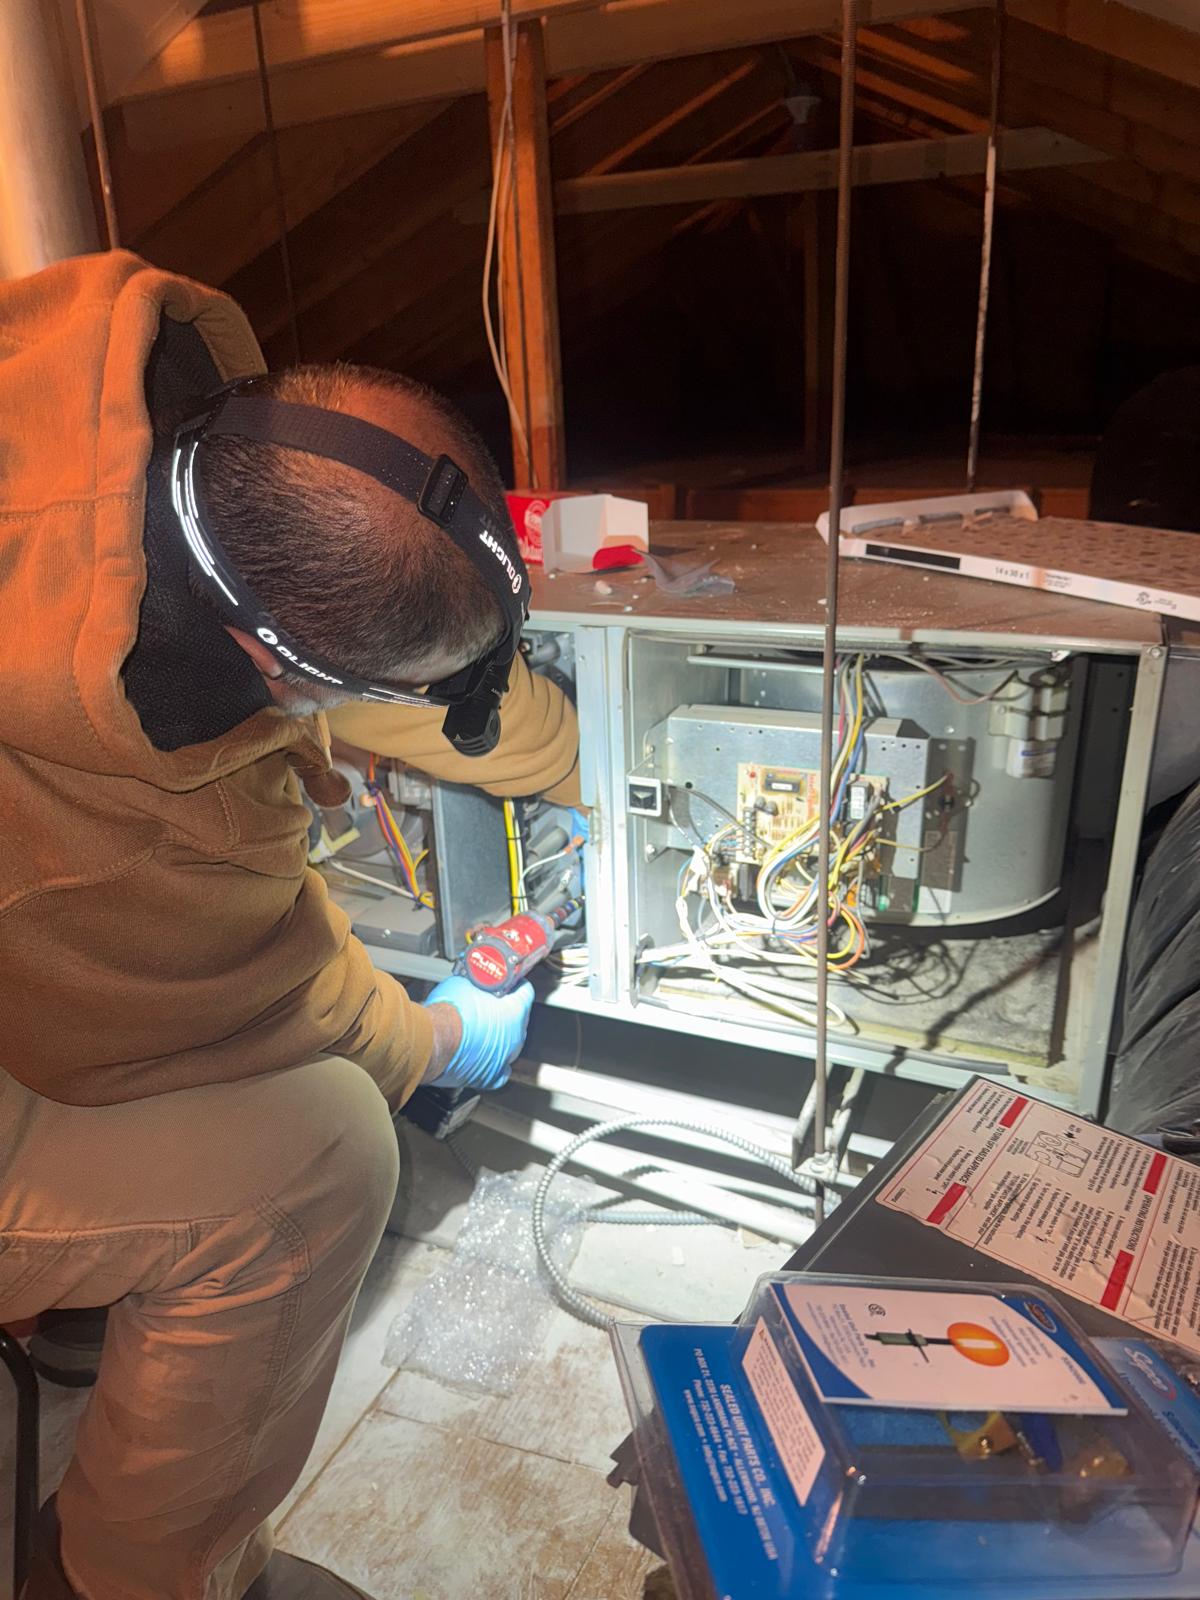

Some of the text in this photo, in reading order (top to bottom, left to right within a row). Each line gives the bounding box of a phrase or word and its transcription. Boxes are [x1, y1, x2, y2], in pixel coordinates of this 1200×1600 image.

[479, 529, 516, 580] OLIGHT
[276, 644, 343, 685] OLIGHT
[958, 1159, 980, 1183] APPLIANCE
[1137, 1193, 1154, 1220] OPERATING
[1125, 1217, 1146, 1251] INSTRUCTIONS
[719, 1383, 741, 1415] SEALED
[731, 1415, 749, 1435] UNIT
[739, 1437, 760, 1467] PARTS
